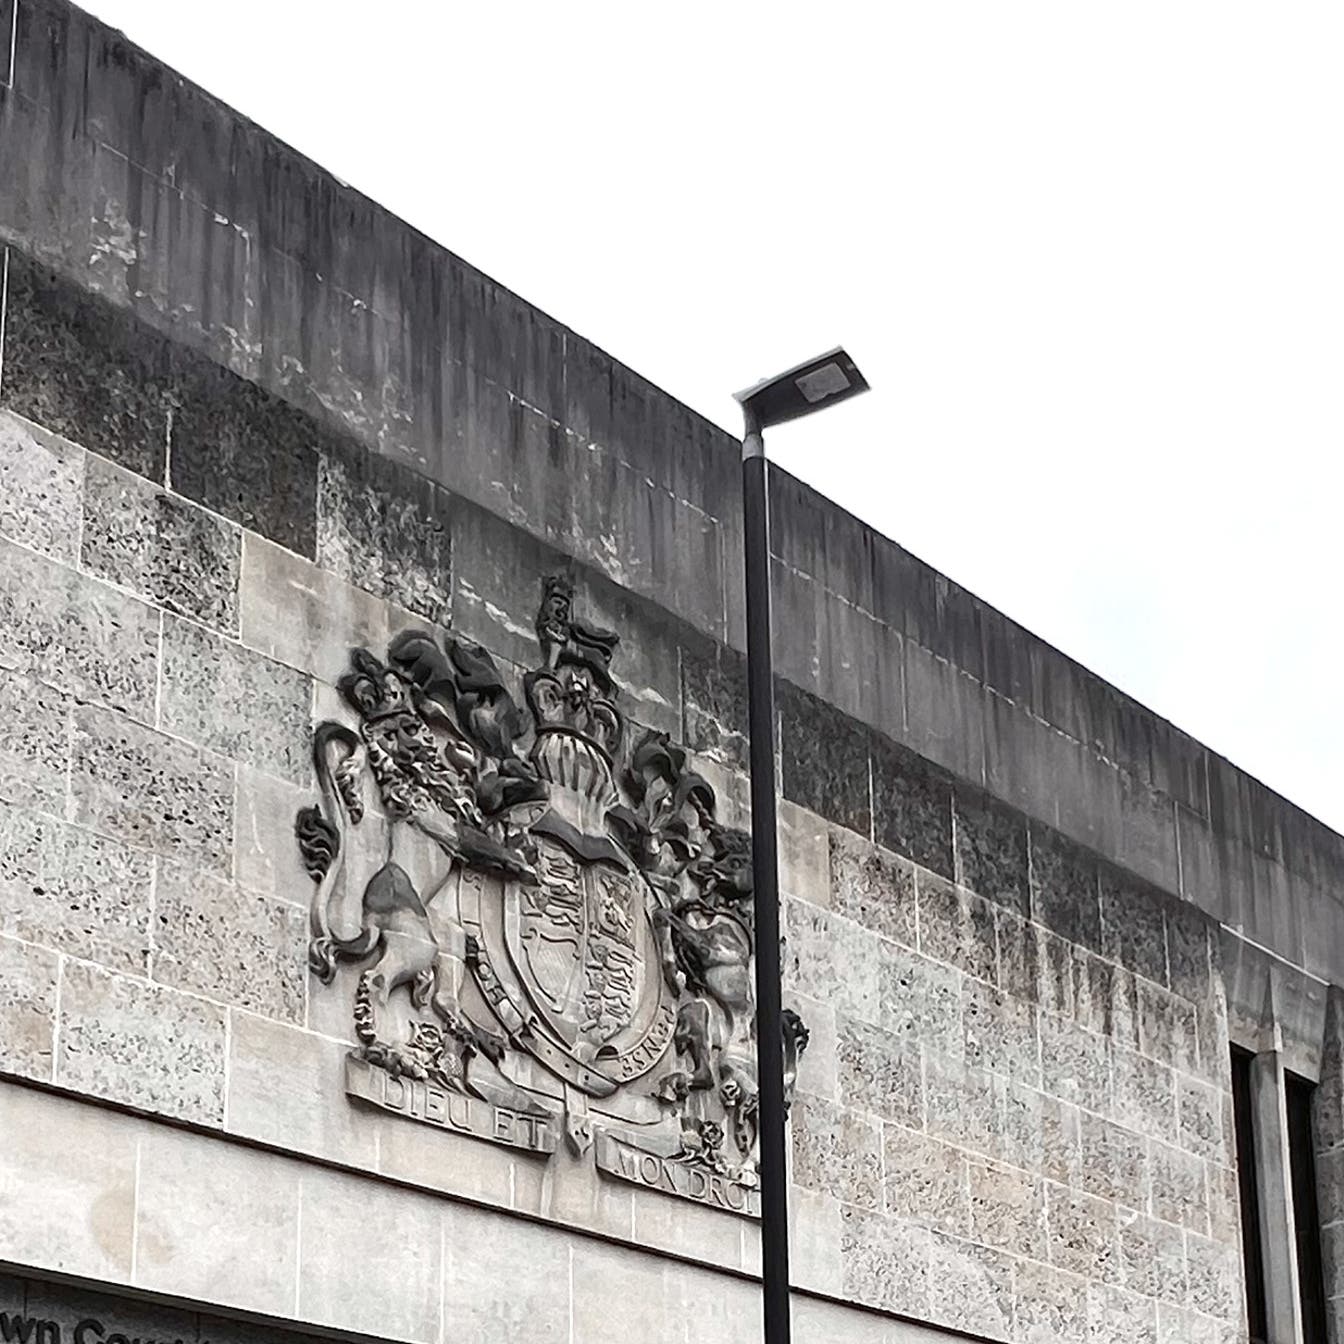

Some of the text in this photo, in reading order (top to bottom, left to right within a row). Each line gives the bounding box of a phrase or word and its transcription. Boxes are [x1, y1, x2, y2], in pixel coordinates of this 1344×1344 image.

[382, 1076, 548, 1149] DIEU ET
[613, 1146, 756, 1215] MON DROI
